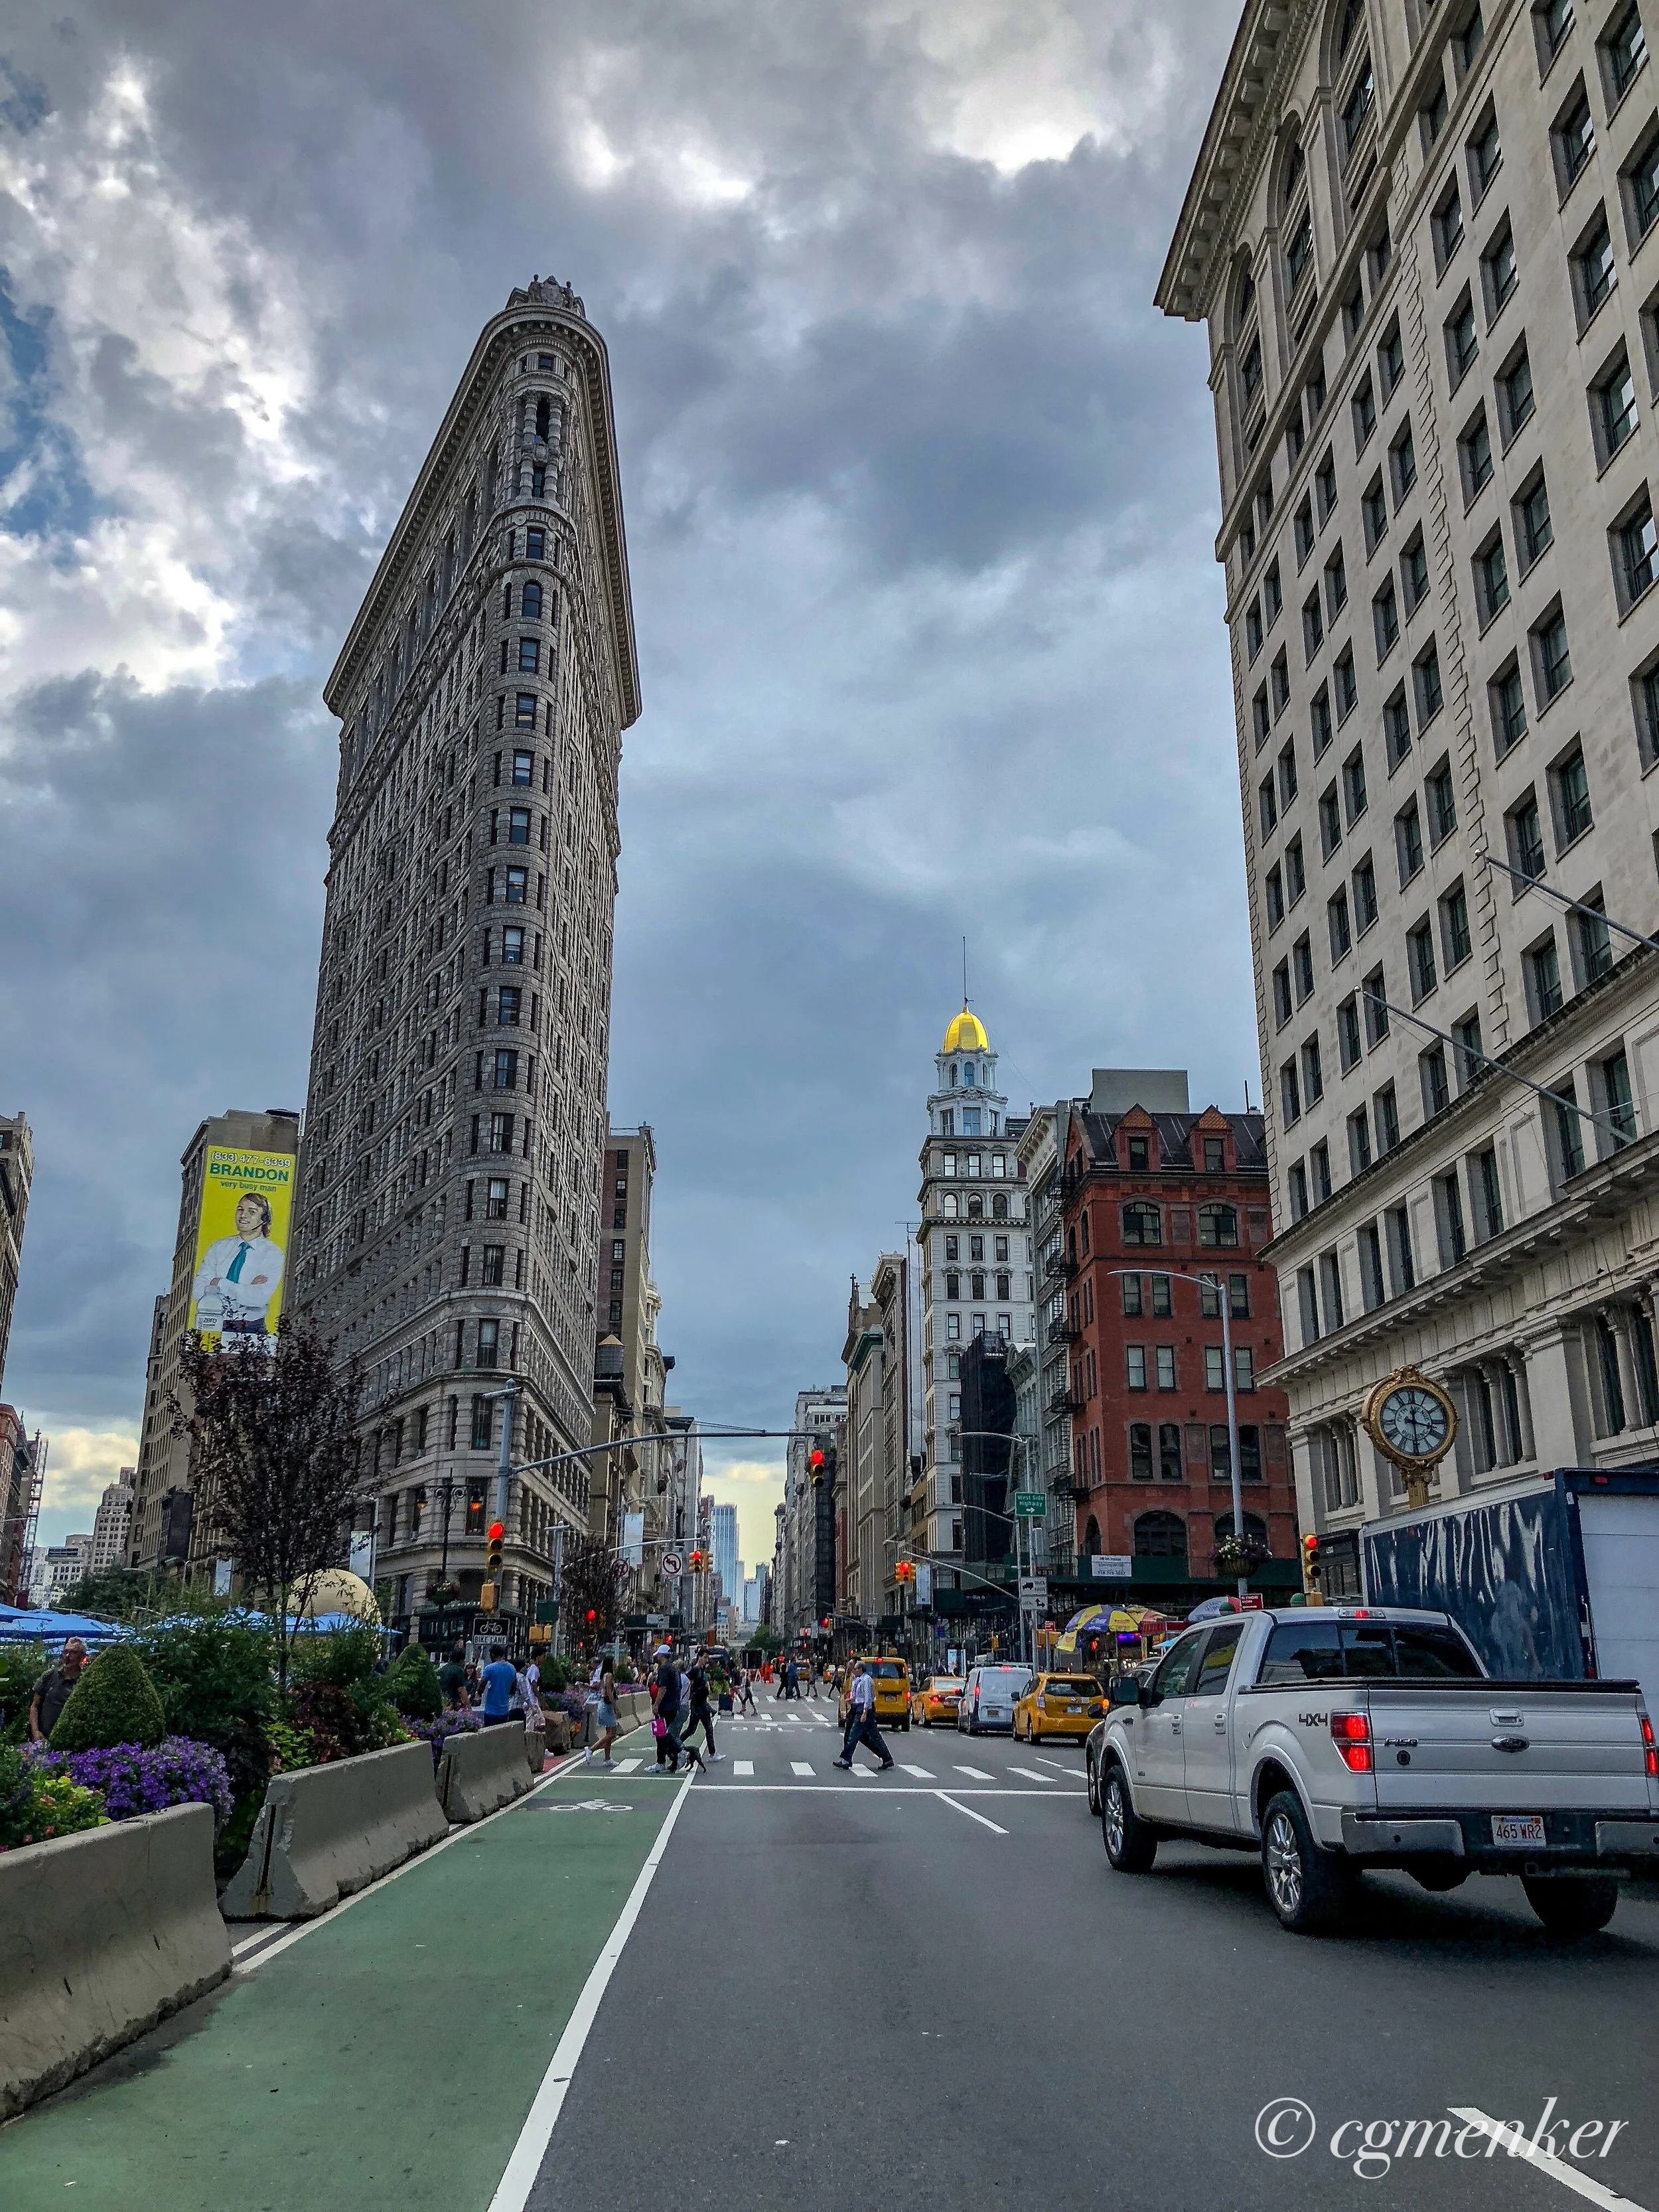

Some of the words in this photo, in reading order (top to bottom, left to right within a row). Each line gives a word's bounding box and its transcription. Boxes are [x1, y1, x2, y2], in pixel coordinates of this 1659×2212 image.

[212, 1151, 238, 1163] (833)
[240, 1154, 291, 1167] 477-8339
[210, 1163, 289, 1181] BRANDON
[220, 1181, 237, 1189] very
[239, 1181, 257, 1191] busy
[1402, 1429, 1428, 1439] BUILING
[474, 1635, 489, 1644] BIKE
[491, 1635, 506, 1645] LANE
[1496, 1824, 1518, 1838] 465
[1520, 1824, 1542, 1838] WR2
